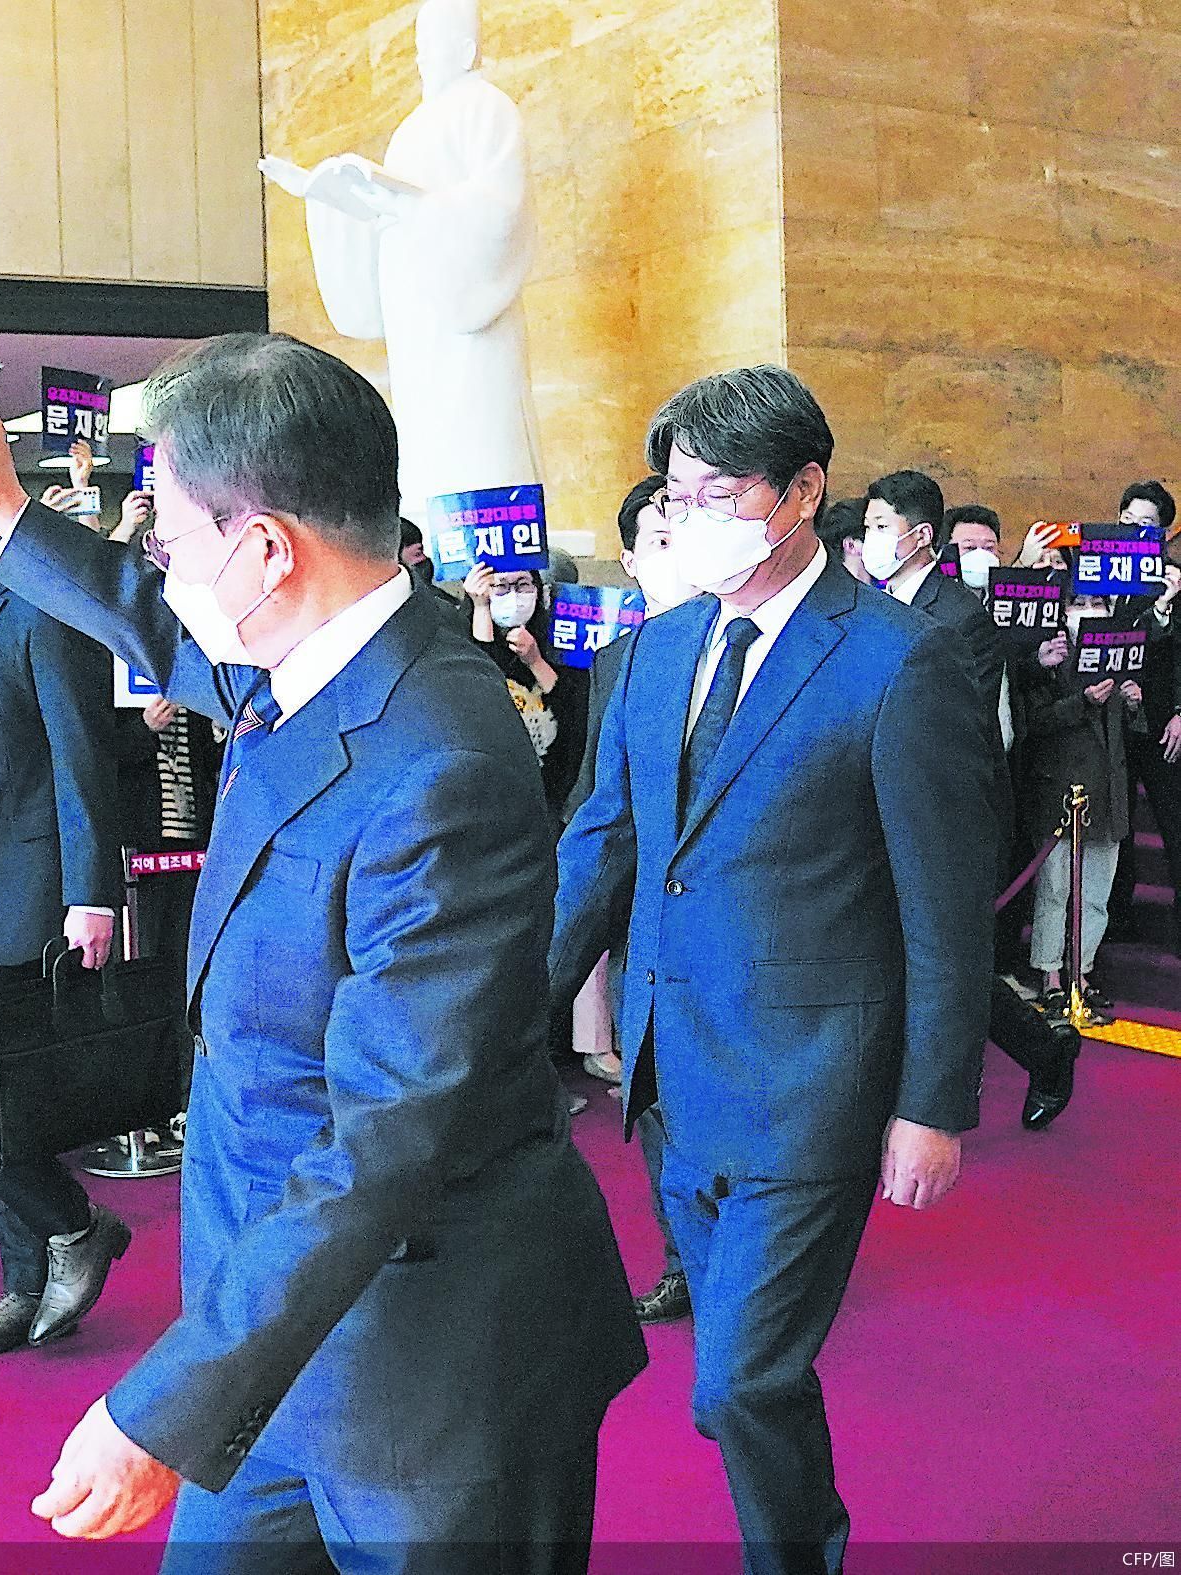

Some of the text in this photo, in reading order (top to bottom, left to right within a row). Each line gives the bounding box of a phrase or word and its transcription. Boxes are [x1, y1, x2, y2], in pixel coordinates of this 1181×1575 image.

[47, 405, 109, 442] 문재인
[437, 523, 541, 565] 문재인
[1078, 555, 1163, 582] 문재인
[993, 600, 1060, 628] 문재인
[553, 619, 631, 653] 문재
[1077, 645, 1145, 673] 문재인
